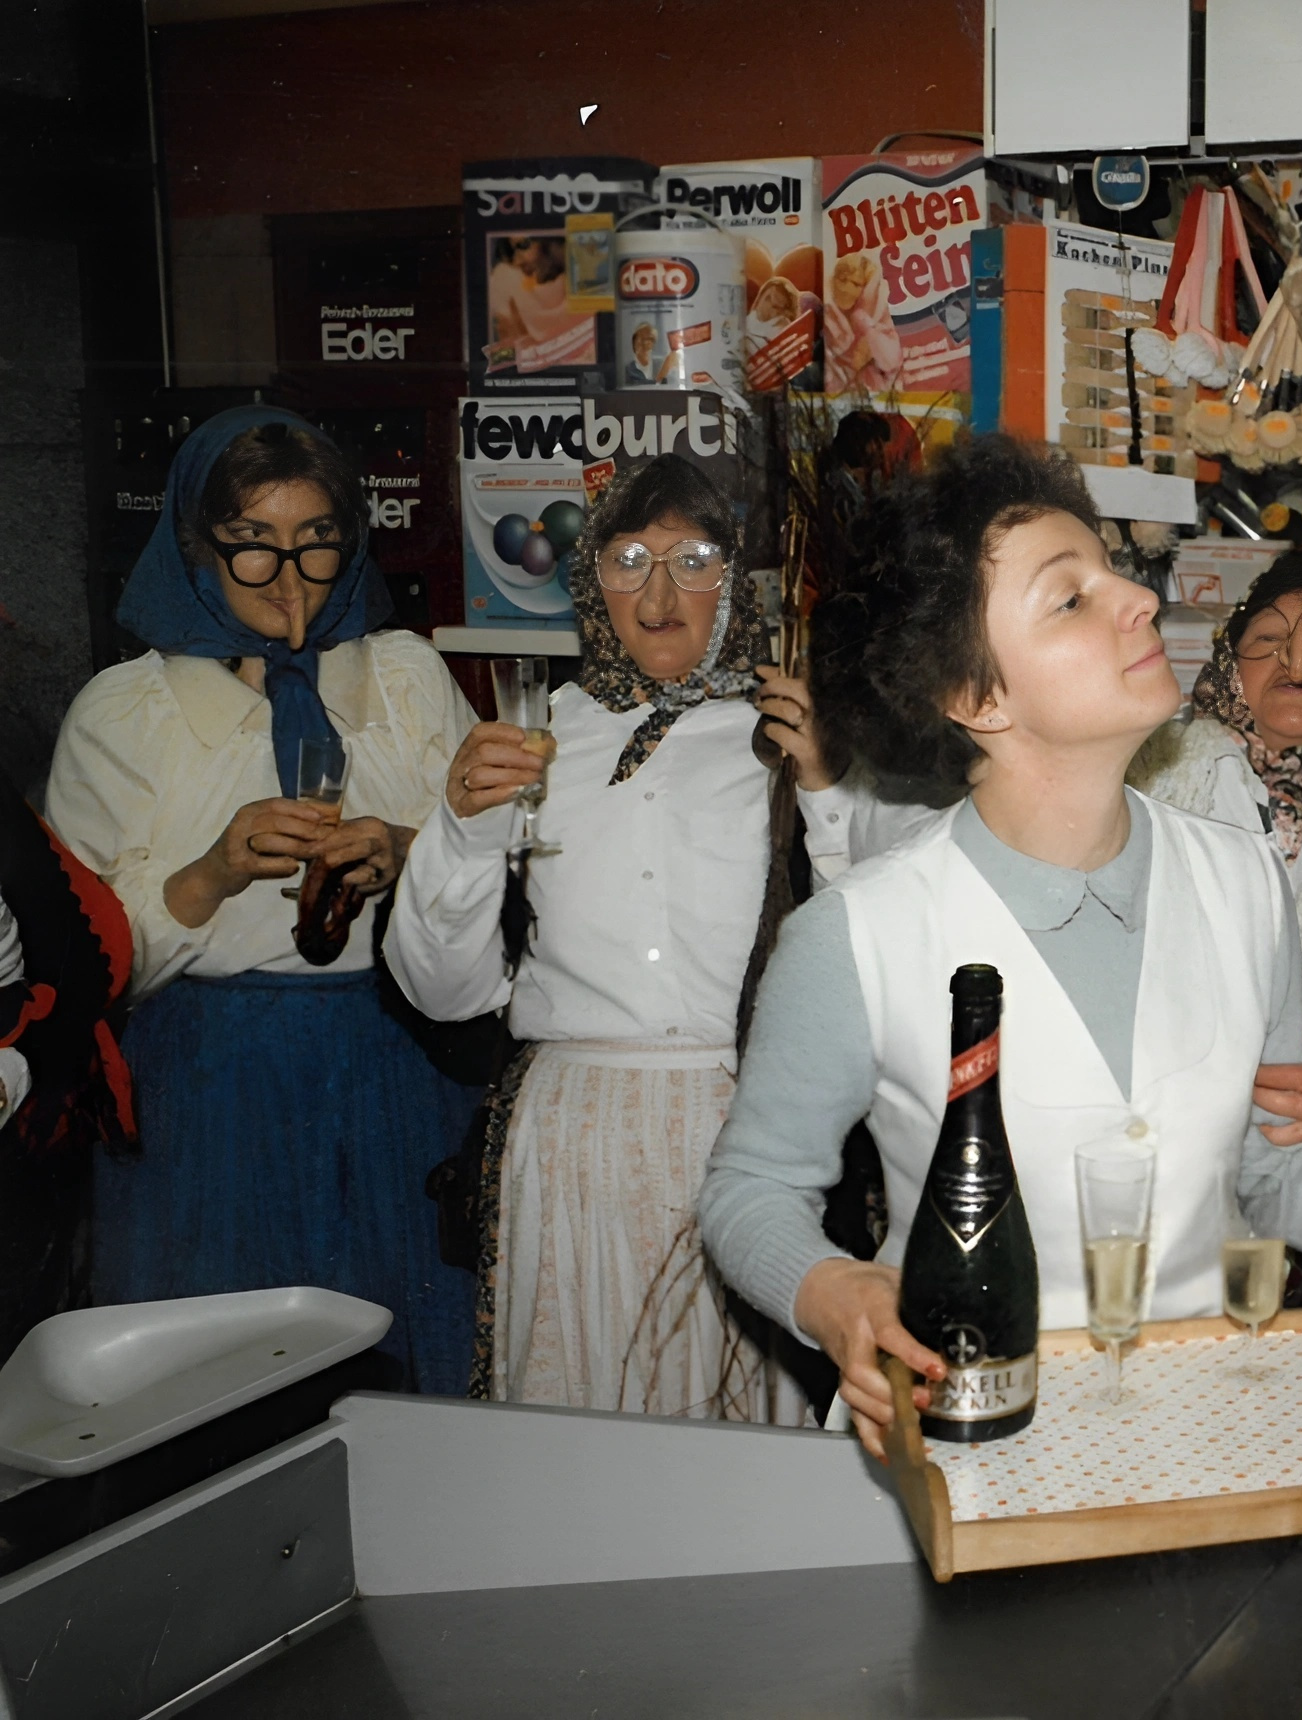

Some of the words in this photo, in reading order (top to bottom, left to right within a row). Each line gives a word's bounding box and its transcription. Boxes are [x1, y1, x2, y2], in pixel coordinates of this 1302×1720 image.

[667, 176, 802, 219] Perwoll
[828, 184, 981, 259] Blüten
[621, 262, 688, 293] dato
[321, 322, 415, 360] Eder
[584, 398, 738, 457] burti
[367, 490, 421, 529] der
